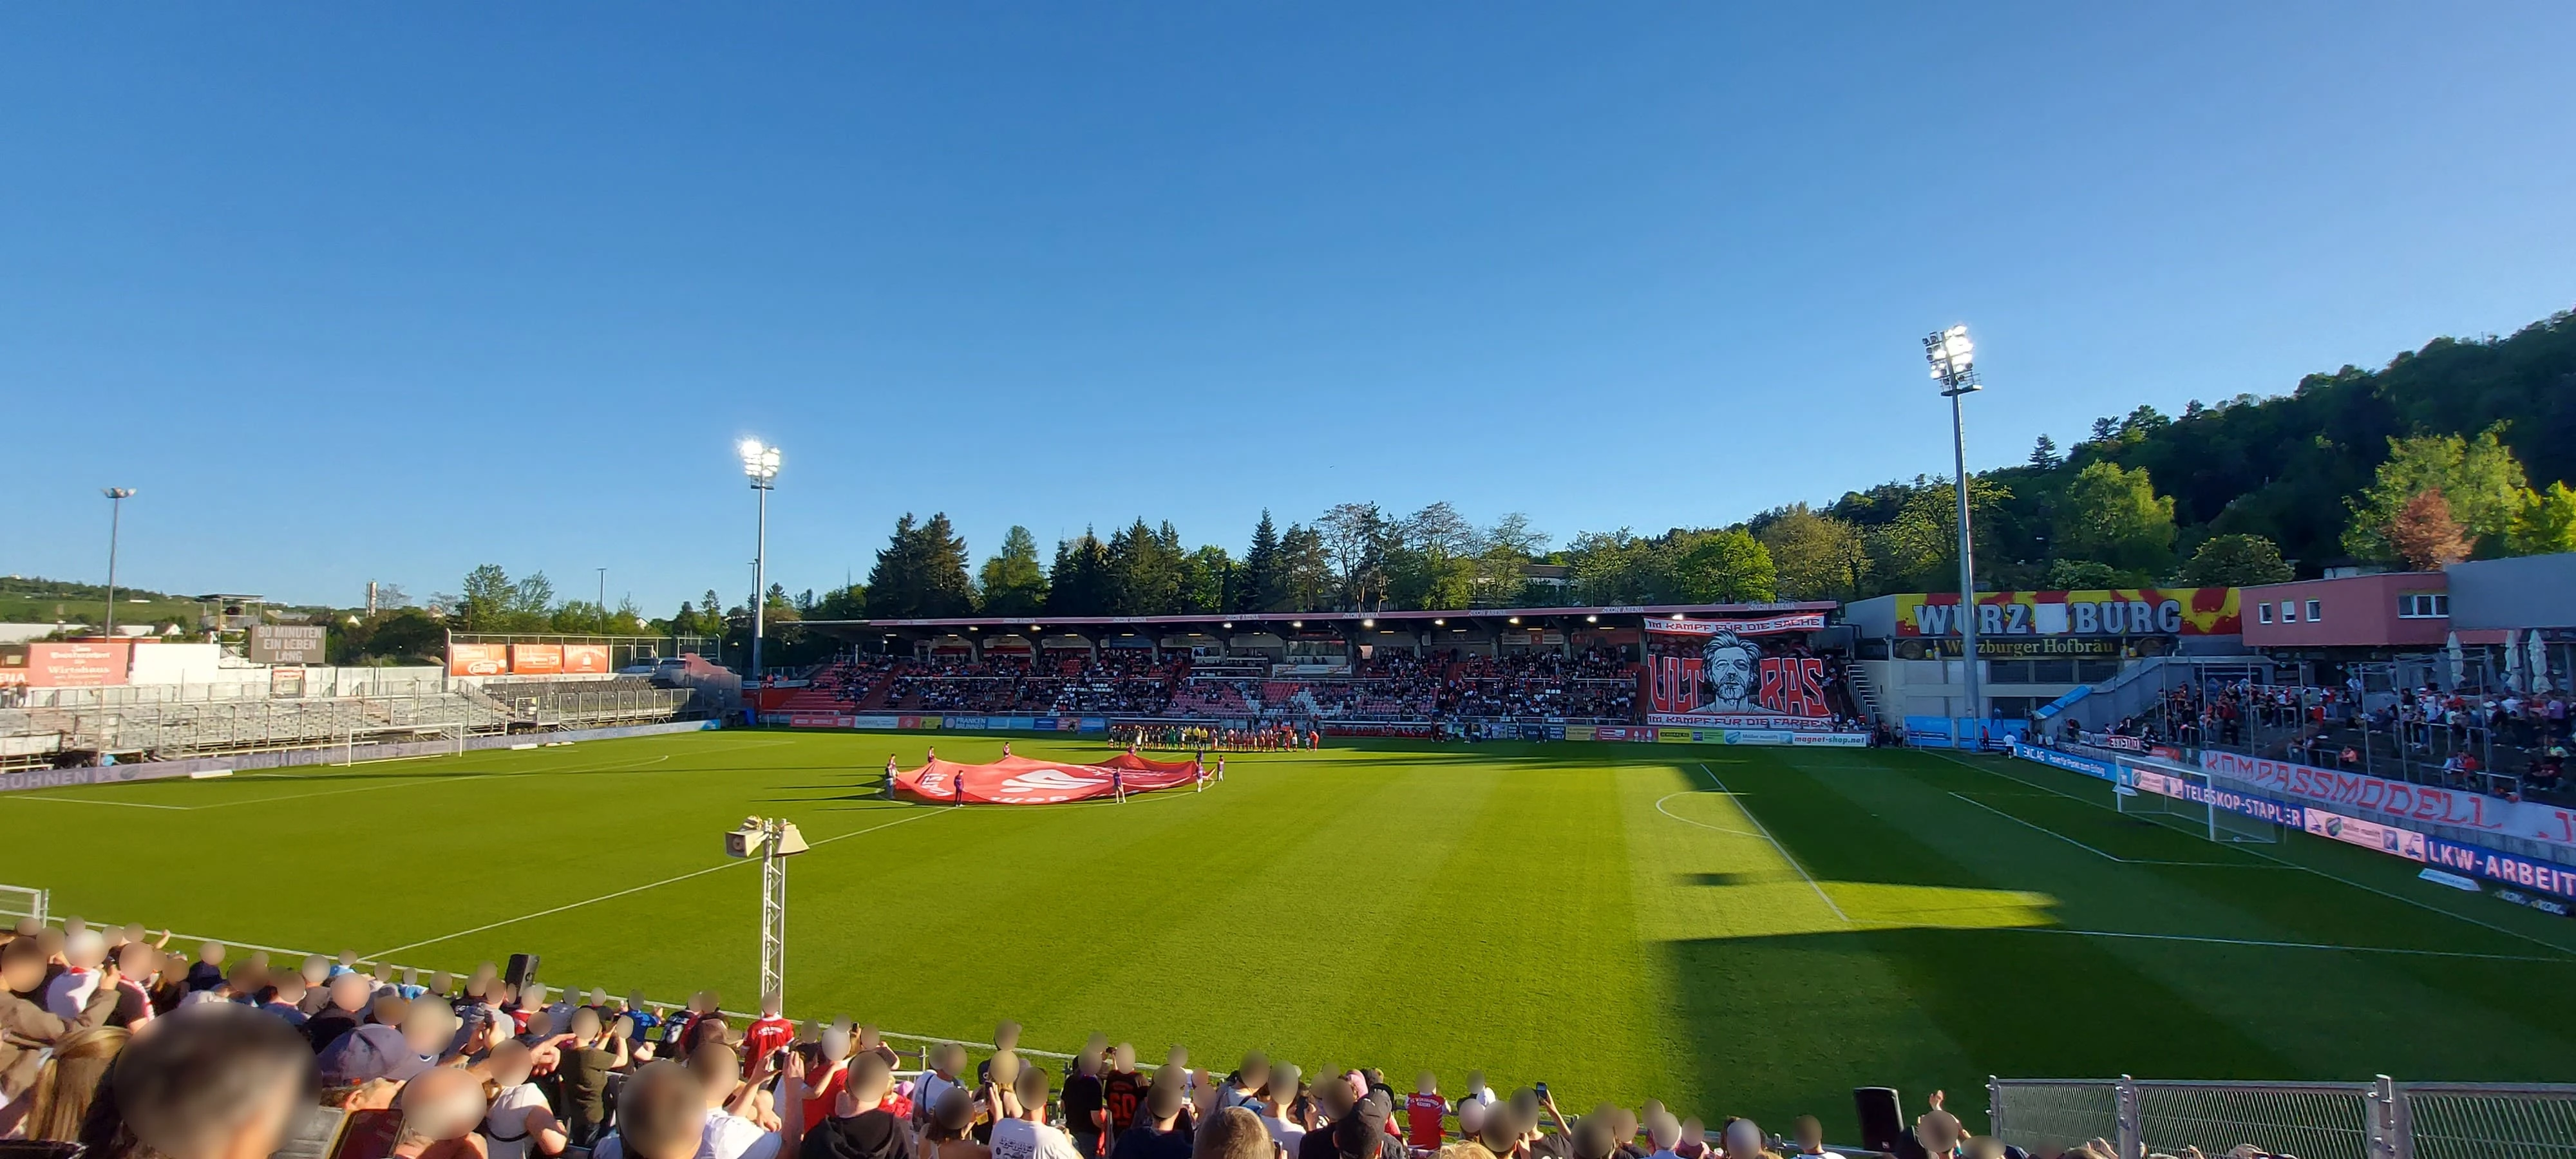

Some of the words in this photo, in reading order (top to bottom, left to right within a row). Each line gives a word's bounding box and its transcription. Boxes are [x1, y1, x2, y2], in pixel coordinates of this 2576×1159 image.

[1666, 623, 1711, 632] KAMPF
[1775, 619, 1820, 628] SACHE
[258, 626, 271, 637] 90
[275, 626, 322, 638] MINUTEN
[263, 638, 281, 650] EIN
[284, 638, 317, 650] LEBEN
[1945, 640, 2040, 657] Wzburger
[2042, 639, 2114, 653] Hofbräu
[275, 650, 303, 661] LANG
[1714, 717, 1742, 726] FÜR
[1794, 733, 1865, 745] magnet-shop.net
[2184, 784, 2302, 827] TELESKOP-STAPLER
